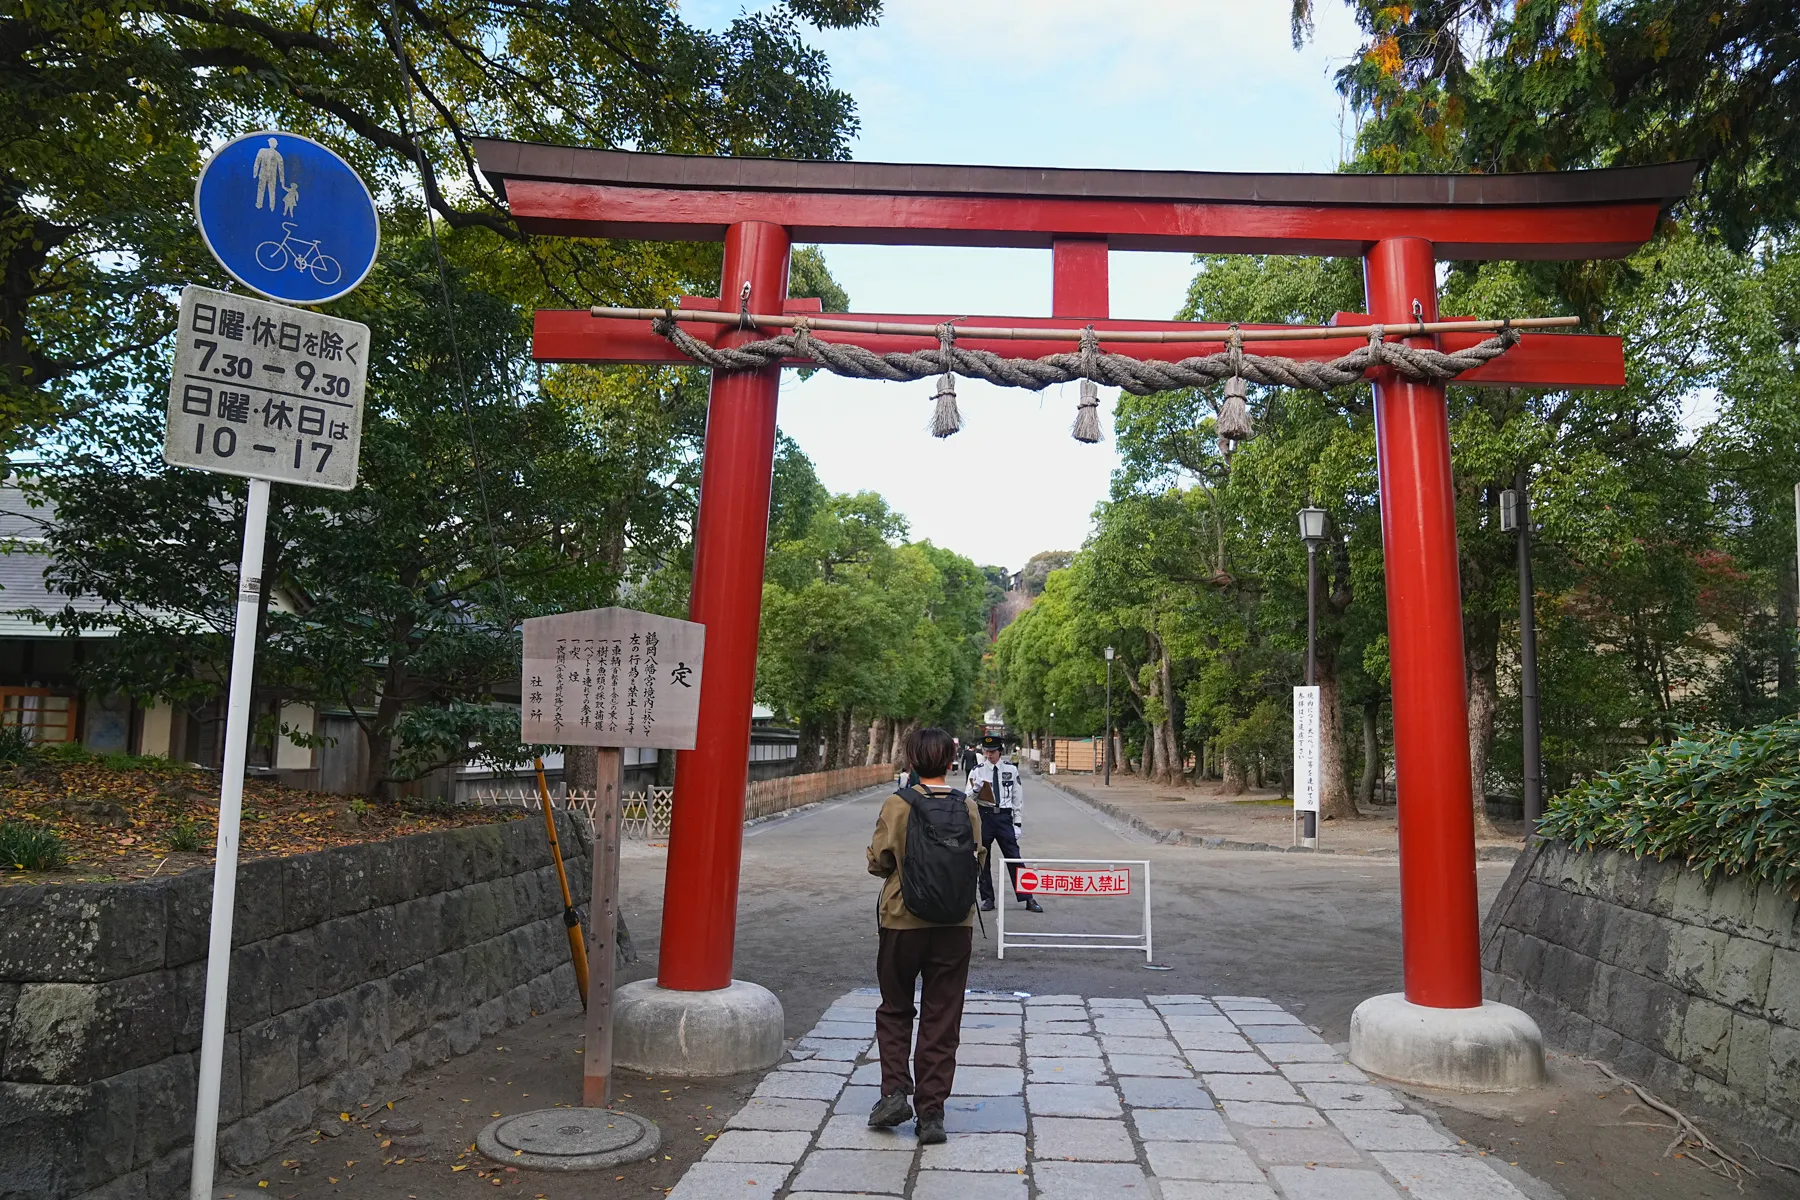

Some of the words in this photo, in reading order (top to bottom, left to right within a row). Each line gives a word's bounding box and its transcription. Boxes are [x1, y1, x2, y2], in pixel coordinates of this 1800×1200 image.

[625, 632, 642, 736] 左の行為を禁止します
[670, 662, 693, 688] 定
[529, 676, 544, 723] 社務所
[1040, 874, 1126, 892] 車両進入禁止
